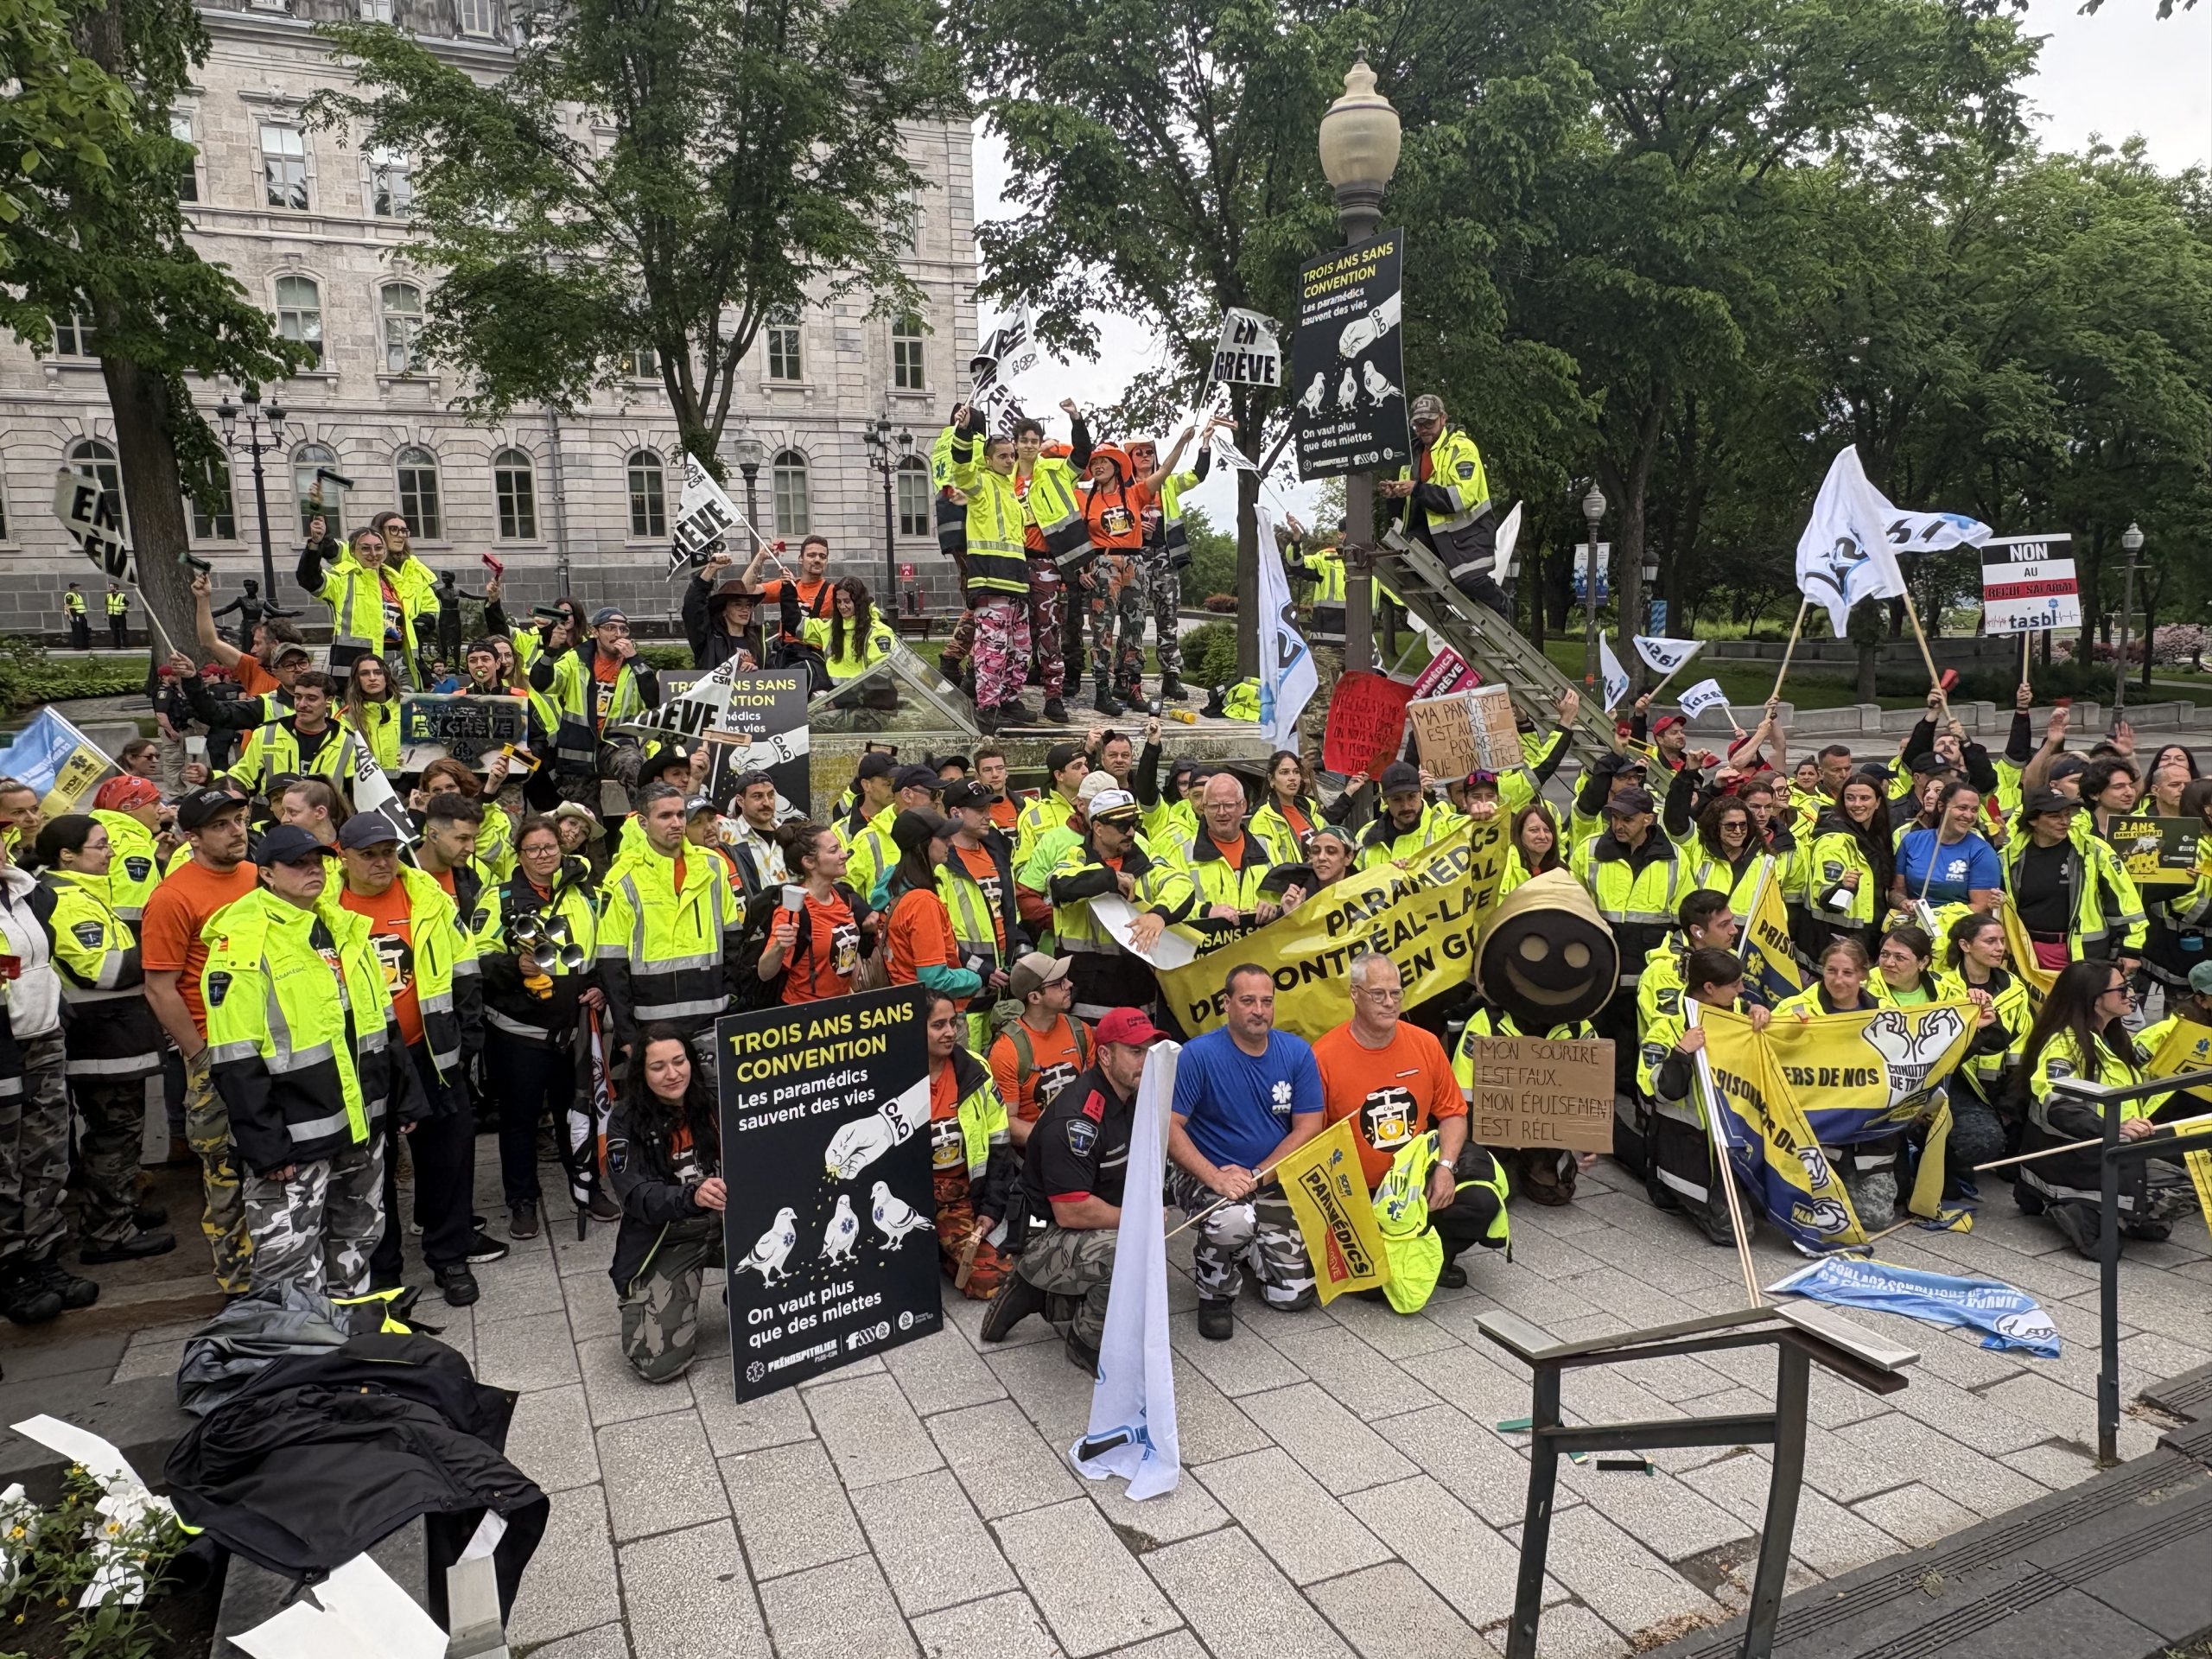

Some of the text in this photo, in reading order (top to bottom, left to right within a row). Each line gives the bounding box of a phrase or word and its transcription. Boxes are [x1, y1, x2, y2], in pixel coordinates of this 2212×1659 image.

[1303, 242, 1393, 283] TROIS ANS SANS
[1304, 264, 1376, 298] CONVENTION
[1301, 300, 1368, 326] sauvent des vies
[1302, 288, 1364, 314] Les paramédics
[1233, 317, 1258, 345] EN
[1372, 308, 1386, 335] CAQ
[1214, 347, 1275, 384] GRÈVE
[1302, 422, 1357, 439] On vaut plus
[1303, 432, 1372, 453] que des miettes
[688, 473, 706, 489] CSN
[669, 498, 733, 567] RÈVE
[2009, 543, 2049, 563] NON
[2024, 567, 2038, 578] AU
[2009, 609, 2056, 629] tasbl
[712, 675, 731, 686] CSN
[756, 679, 797, 691] SANS
[1411, 652, 1455, 702] ARAMÉDICS
[1432, 662, 1465, 698] GRÈVE
[1414, 691, 1510, 727] MA PANCARTE
[743, 724, 766, 734] vies
[1427, 723, 1453, 741] EST
[772, 735, 791, 762] CAQ
[1426, 757, 1452, 779] QUE
[2119, 822, 2155, 833] 3 ANS
[1325, 826, 1499, 938] PARAMÉDCS
[1188, 988, 1227, 1024] DE
[729, 1002, 914, 1056] TROIS ANS SANS
[737, 1033, 887, 1083] CONVENTION
[1480, 1039, 1600, 1065] MON SOURIRE
[738, 1068, 868, 1110] Les paramédics
[1482, 1066, 1563, 1087] EST FAUX.
[1818, 1067, 1840, 1087] DE
[1842, 1067, 1879, 1087] NOS
[1890, 1075, 1904, 1091] DE
[738, 1087, 875, 1132] sauvent des vies
[1481, 1090, 1614, 1121] MON ÉPUISEMENT
[885, 1102, 909, 1141] CAQ
[1481, 1117, 1512, 1137] EST
[1773, 1128, 1797, 1156] DE
[747, 1281, 855, 1325] On vaut plus
[749, 1292, 882, 1349] que des miettes
